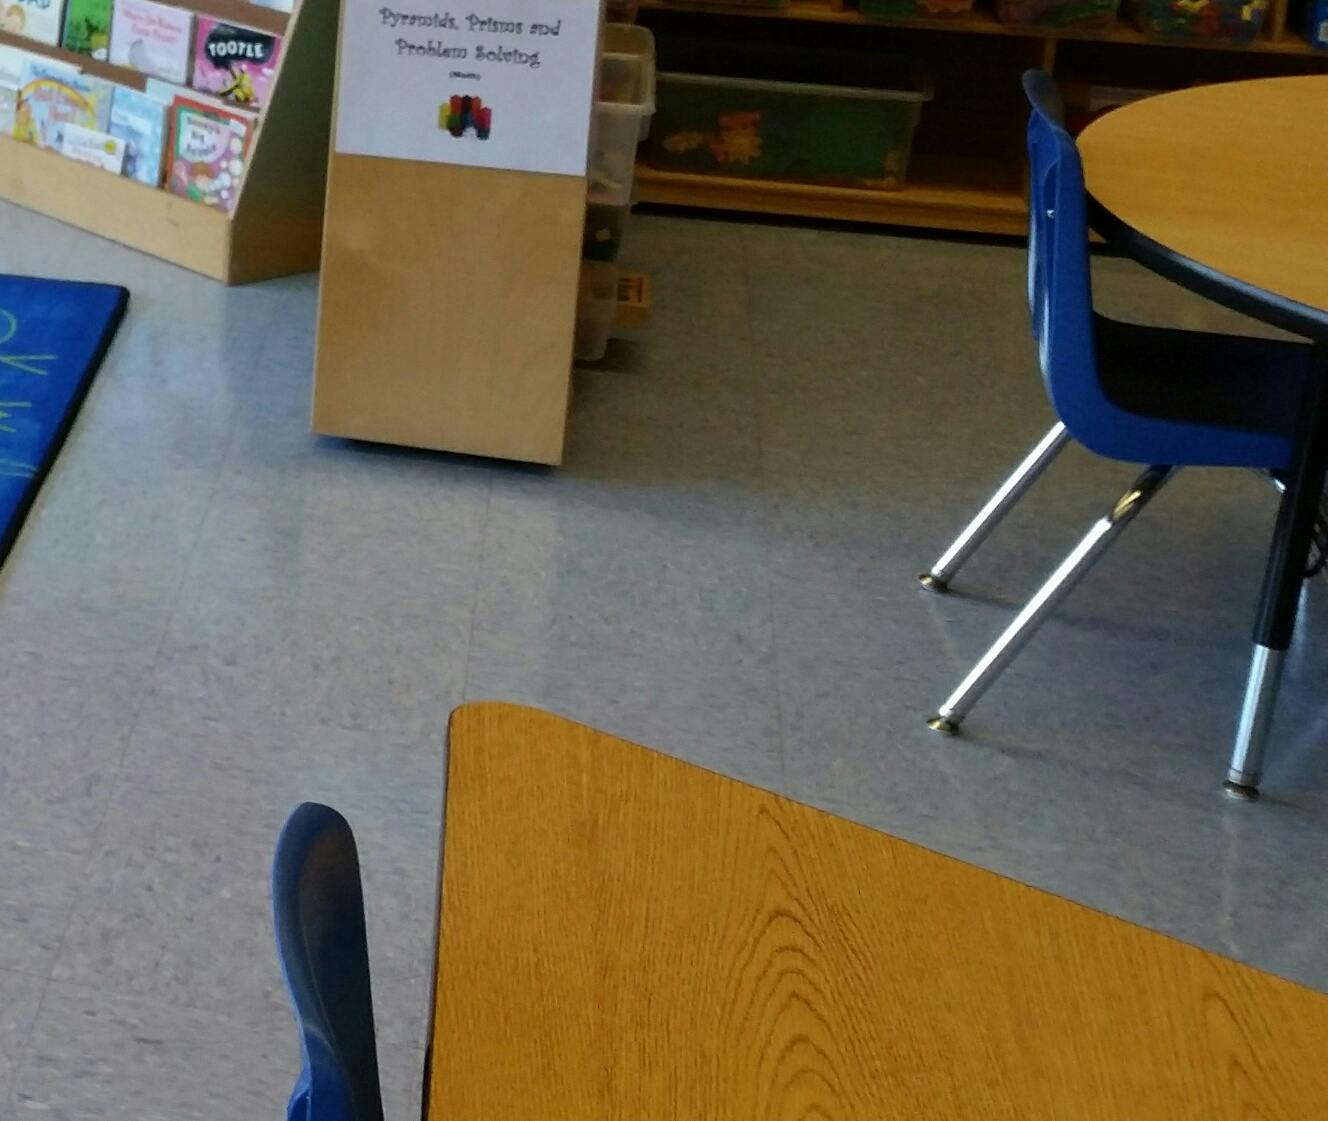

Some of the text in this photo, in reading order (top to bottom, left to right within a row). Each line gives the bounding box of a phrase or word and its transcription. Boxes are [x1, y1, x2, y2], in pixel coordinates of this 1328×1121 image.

[465, 7, 524, 35] Prisms
[528, 19, 562, 37] and
[207, 40, 265, 58] TOOTLE
[394, 36, 543, 69] Problem Solving
